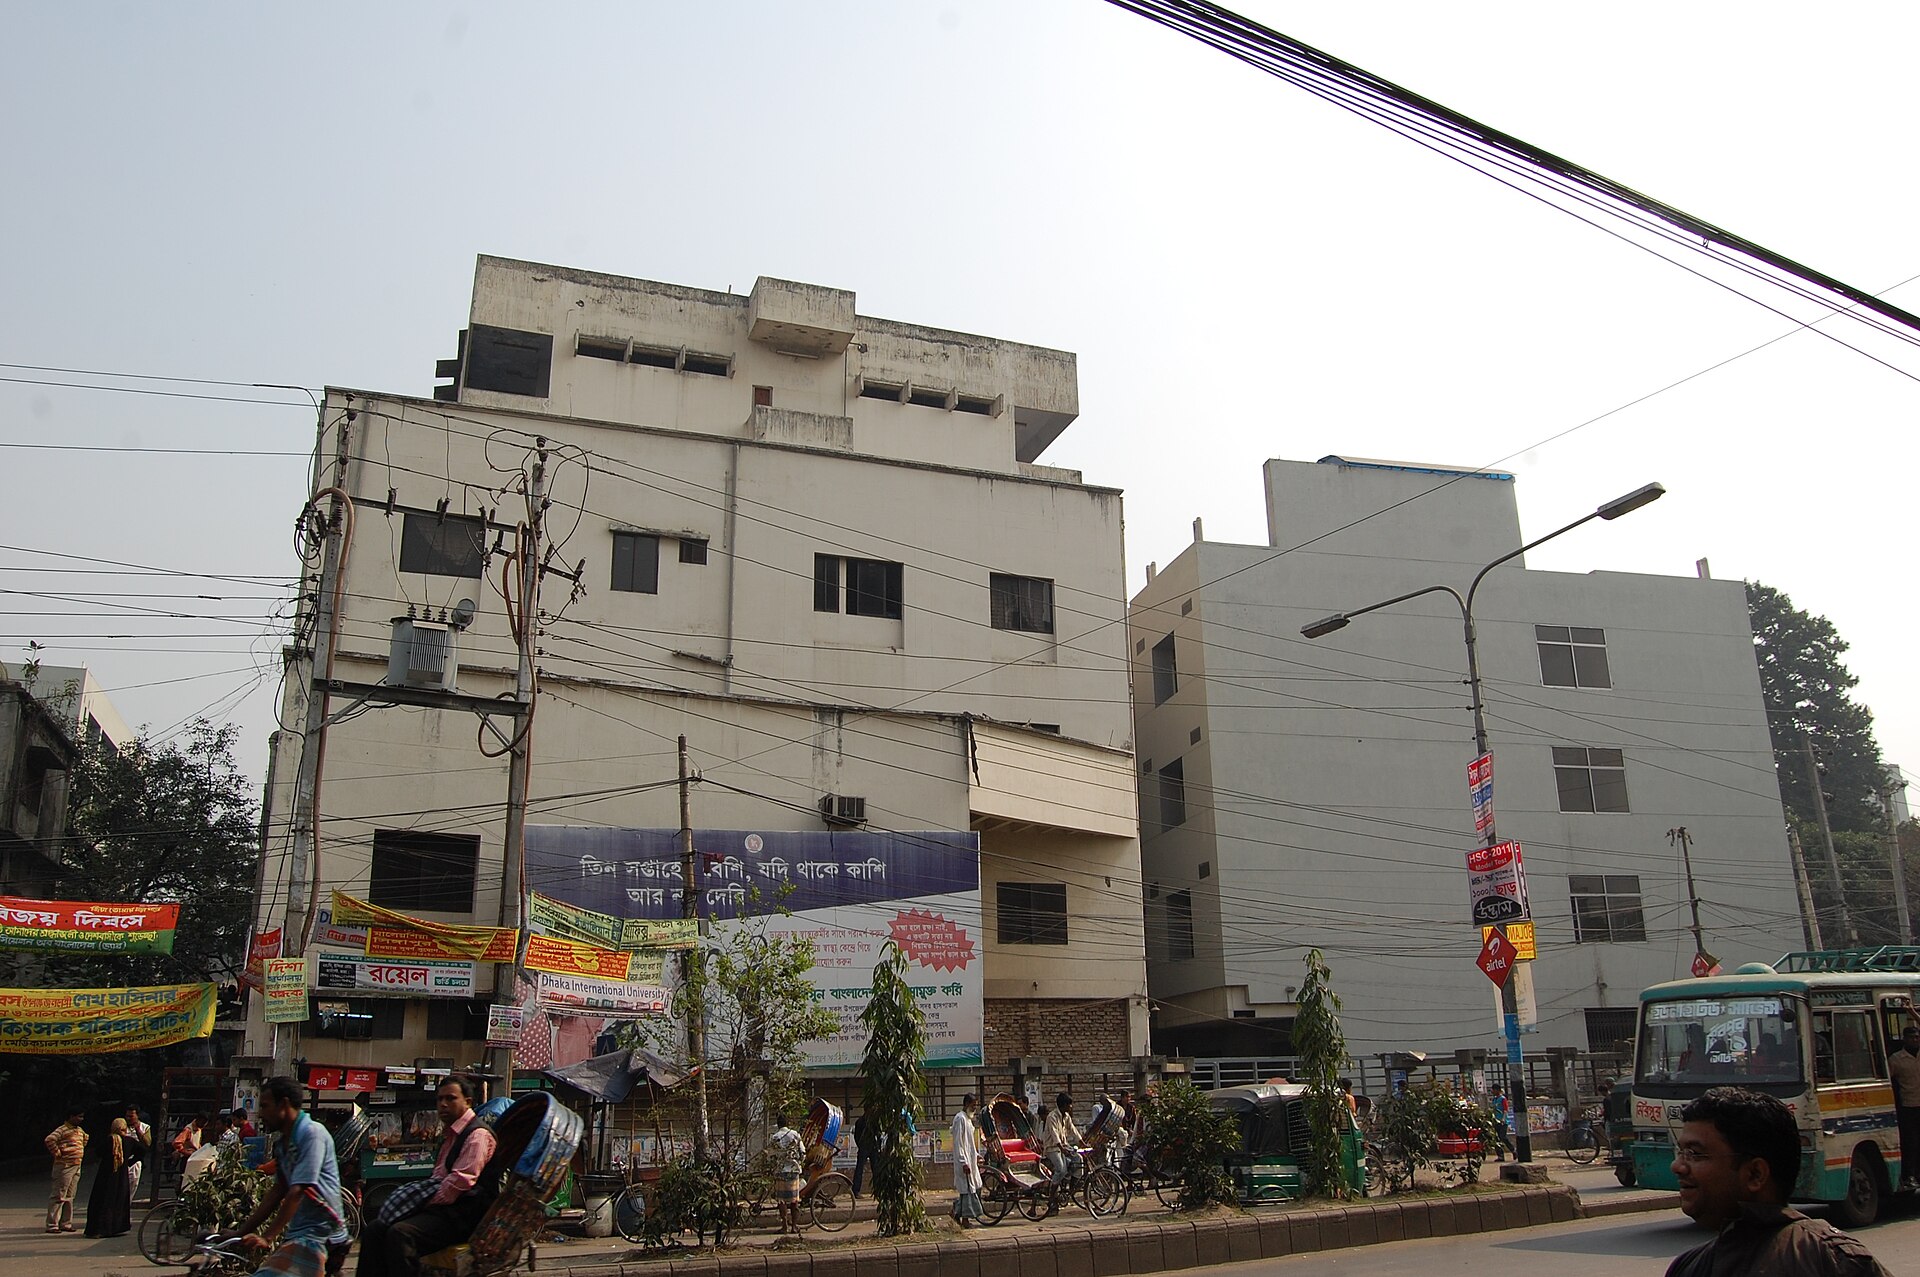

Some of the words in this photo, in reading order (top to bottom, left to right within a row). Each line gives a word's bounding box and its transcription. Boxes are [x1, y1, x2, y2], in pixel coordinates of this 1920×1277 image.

[1468, 843, 1511, 864] HSC-2011
[579, 854, 618, 878] তিন
[624, 859, 684, 880] সপ্তাহে
[703, 856, 751, 882] বশি,
[756, 857, 789, 879] যদি
[796, 861, 839, 879] থাকে
[844, 857, 887, 880] কাশি
[1475, 862, 1493, 871] Model
[1494, 857, 1508, 866] Test
[626, 887, 664, 906] আর
[1494, 881, 1517, 896] ছাড়
[73, 910, 146, 929] দিবসে
[269, 960, 304, 973] দিশা
[1486, 957, 1506, 972] airtel
[367, 965, 430, 986] রয়েল
[542, 974, 570, 991] Dhaka
[572, 980, 625, 996] International
[627, 986, 664, 1000] University
[808, 988, 825, 1002] সুন
[941, 982, 963, 996] করি
[73, 993, 106, 1008] শেখ
[316, 1077, 328, 1086] রবি
[1636, 1101, 1663, 1123] মিরপুর
